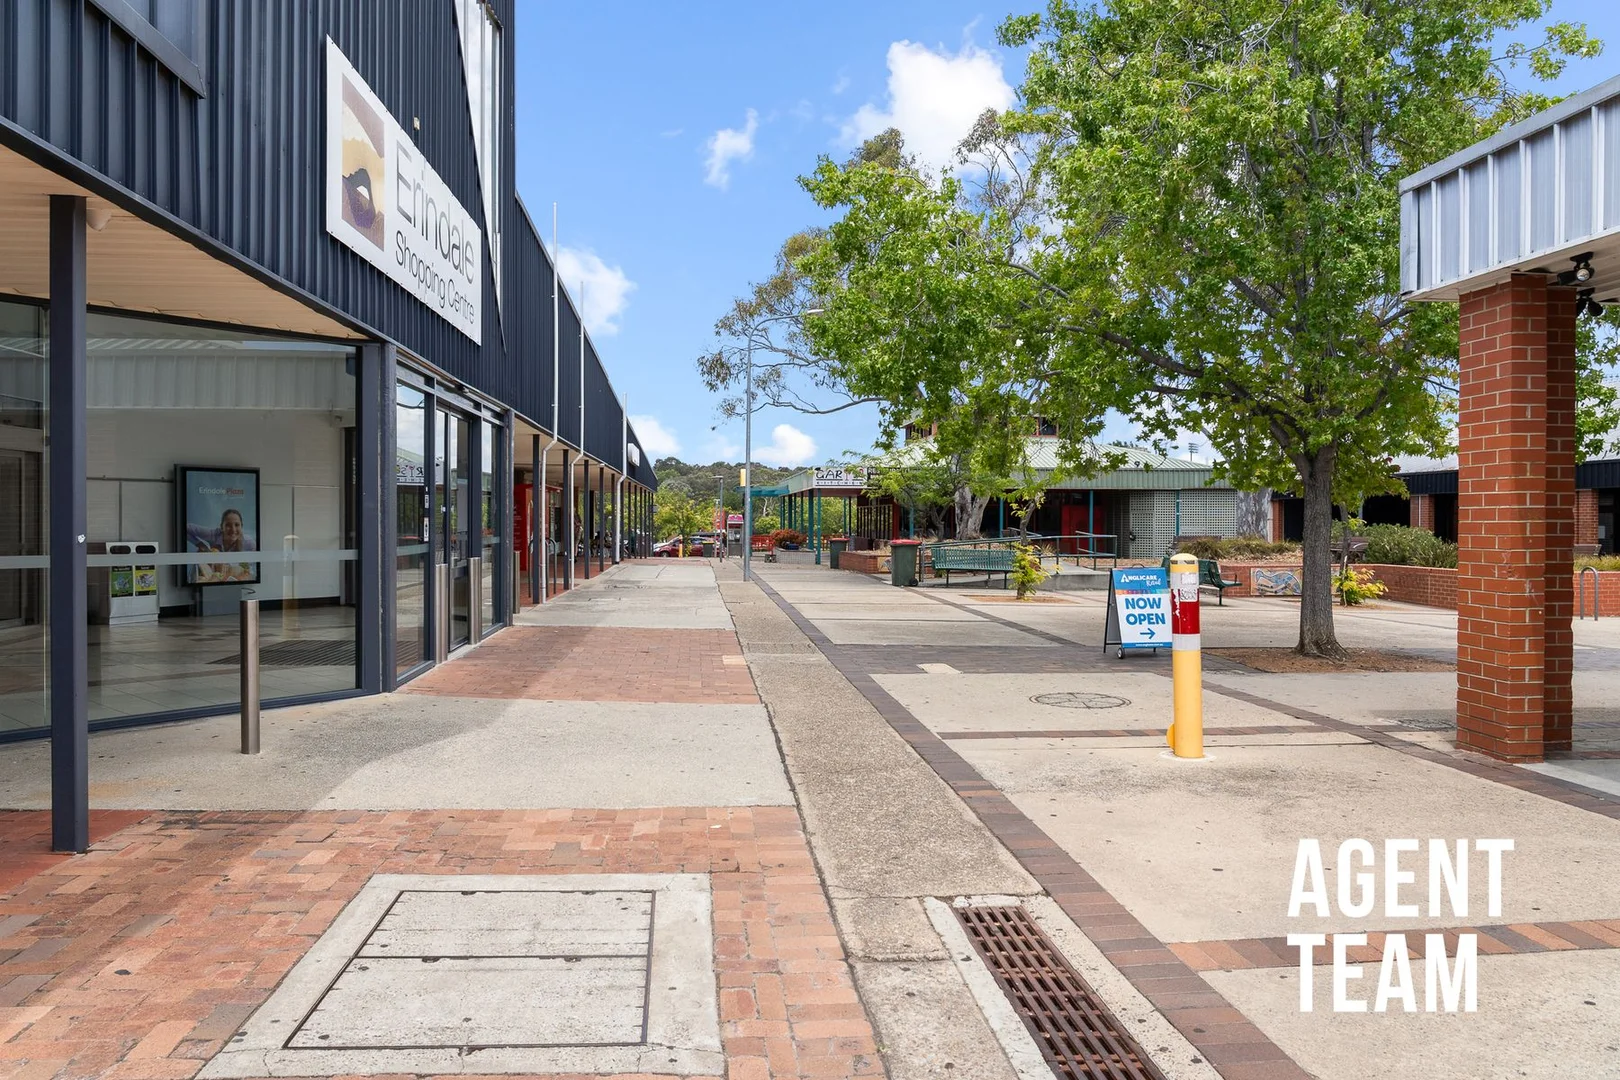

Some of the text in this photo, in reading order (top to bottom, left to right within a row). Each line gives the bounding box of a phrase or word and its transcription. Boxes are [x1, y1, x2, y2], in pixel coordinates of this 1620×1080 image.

[395, 139, 475, 285] Erindale
[395, 230, 475, 325] Shopping Centre
[1120, 573, 1157, 583] ANGLICARE
[1125, 597, 1162, 610] NOW
[1125, 612, 1166, 625] OPEN
